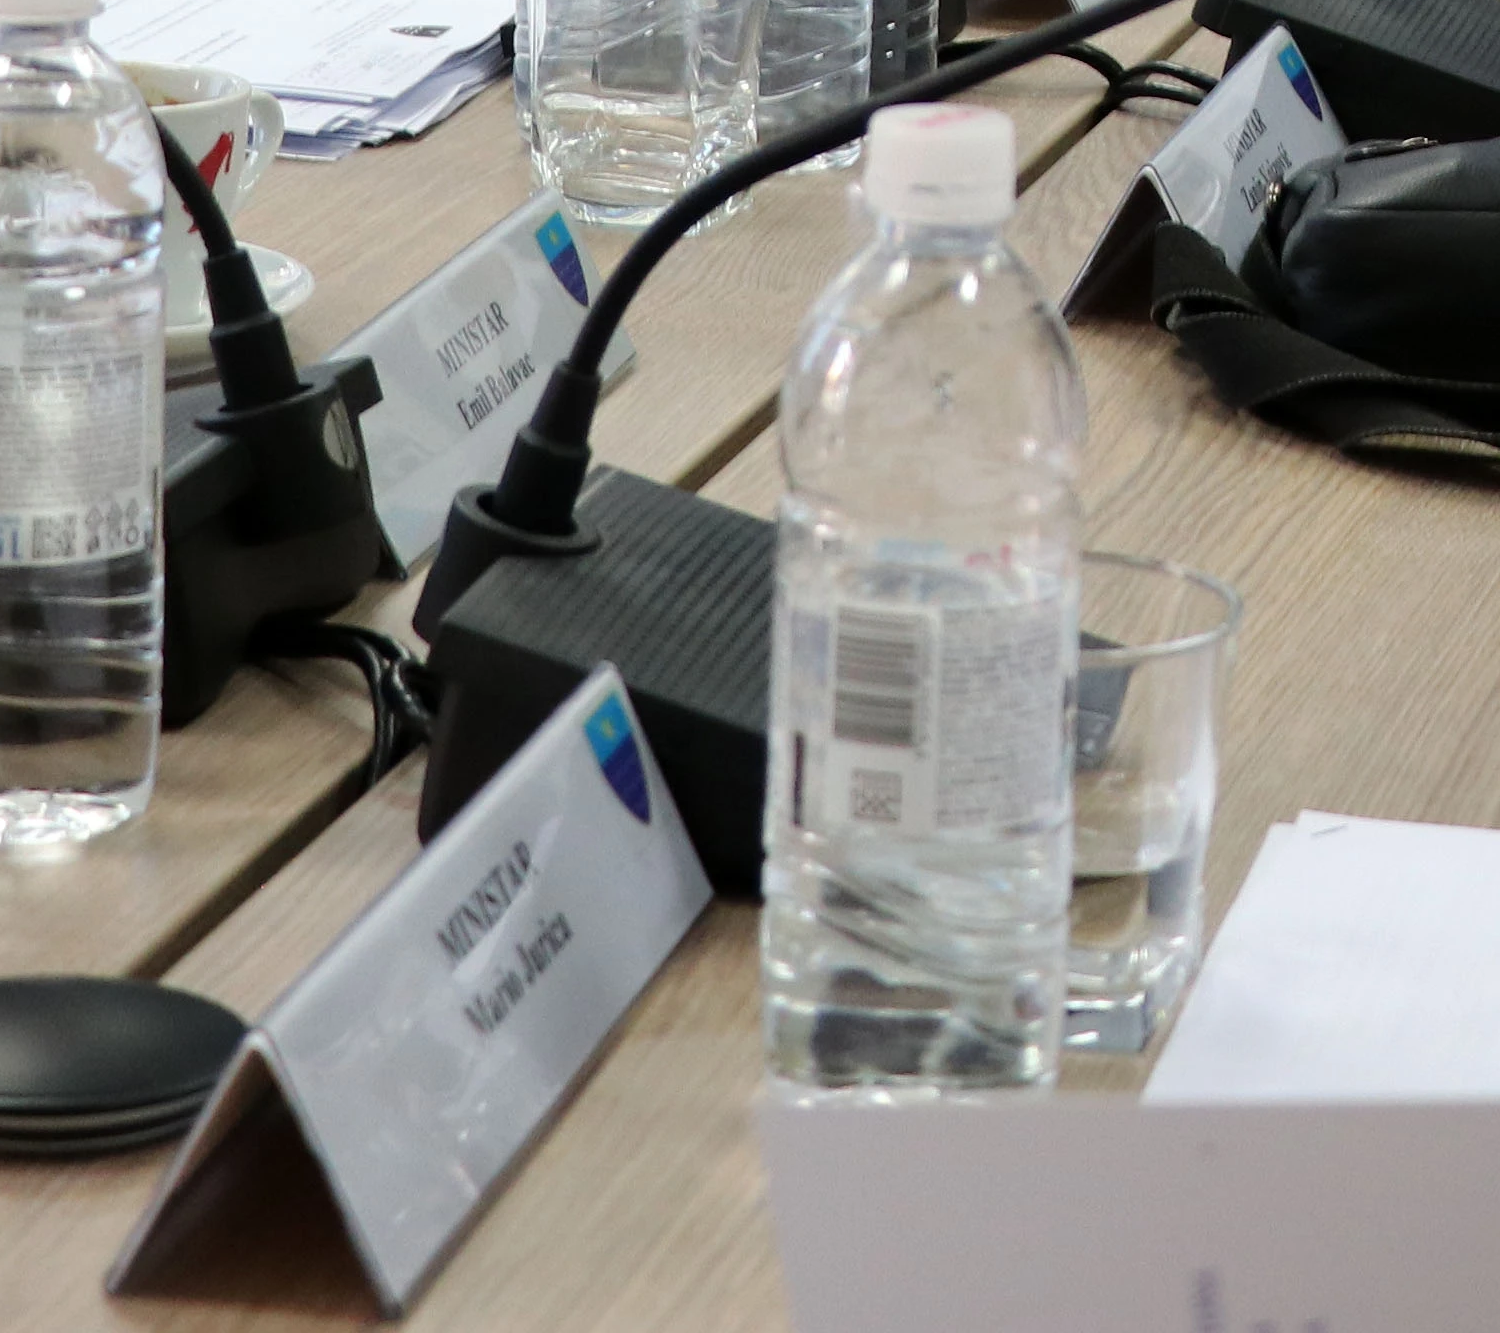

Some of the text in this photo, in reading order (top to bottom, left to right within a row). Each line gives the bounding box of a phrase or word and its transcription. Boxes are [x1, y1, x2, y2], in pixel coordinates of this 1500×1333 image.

[436, 300, 509, 379] MINISTAR
[456, 352, 537, 431] Emil Balavac
[463, 966, 524, 1037] Mario
